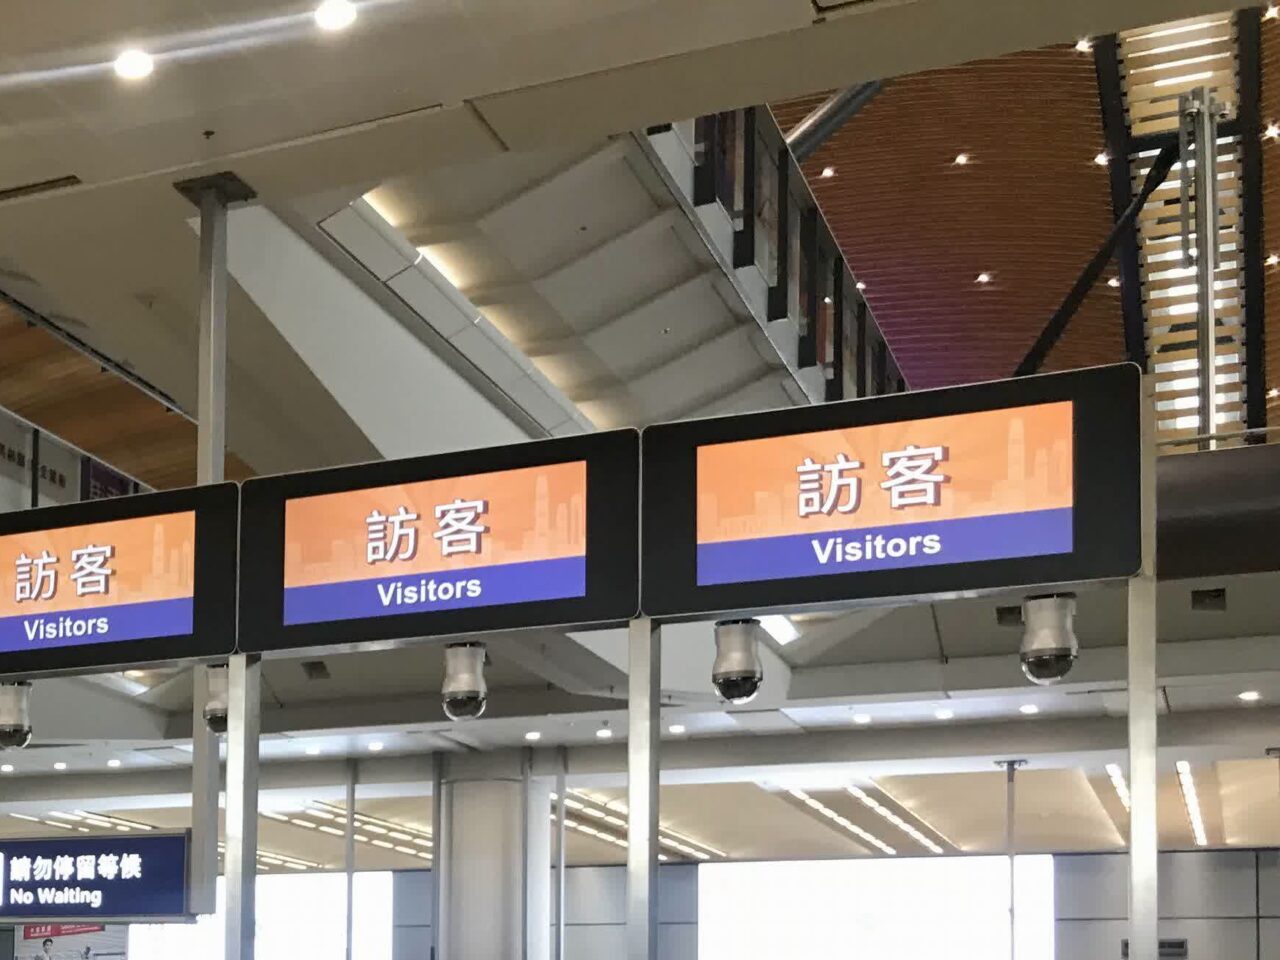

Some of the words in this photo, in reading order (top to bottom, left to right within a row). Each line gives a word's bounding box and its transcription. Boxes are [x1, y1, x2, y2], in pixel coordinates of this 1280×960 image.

[796, 444, 950, 518] 訪客
[365, 499, 490, 564] 訪客
[811, 532, 942, 564] Visitors
[14, 543, 116, 602] 訪客
[376, 575, 482, 607] Visitors
[23, 613, 109, 642] Visitors
[10, 888, 33, 904] No
[37, 887, 102, 908] Waiting
